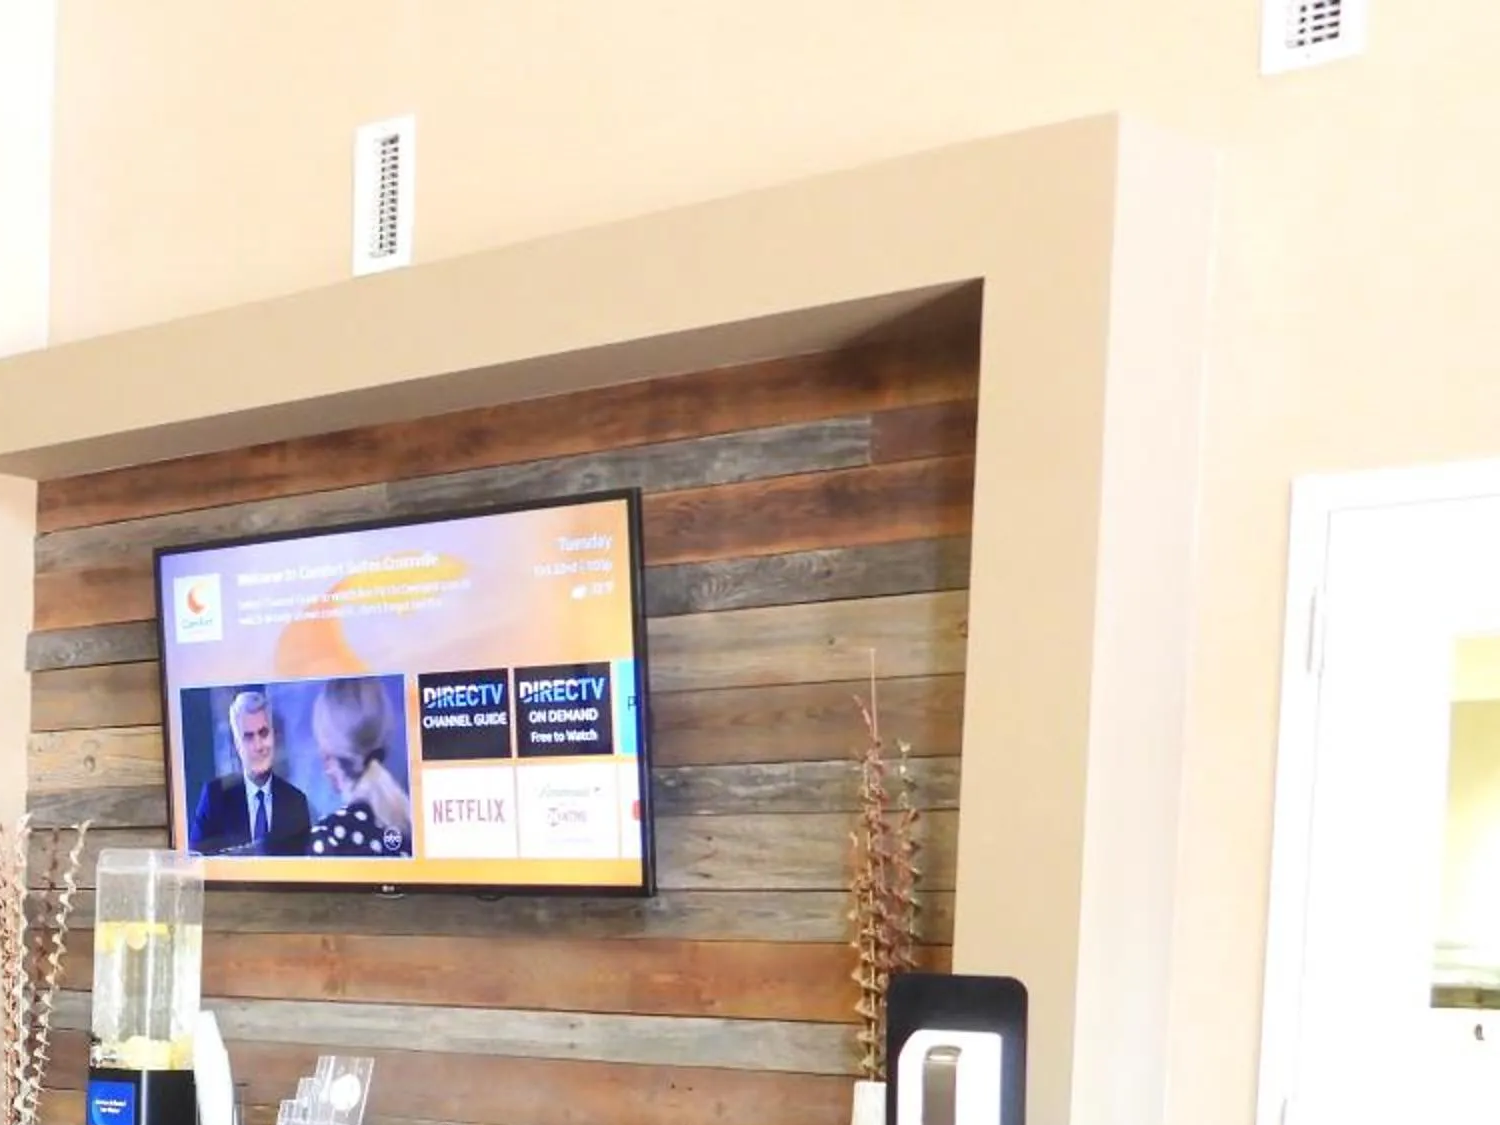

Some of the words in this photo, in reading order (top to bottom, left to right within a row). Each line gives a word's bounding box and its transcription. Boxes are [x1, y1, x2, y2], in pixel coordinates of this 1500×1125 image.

[423, 683, 503, 708] DIRECTV
[519, 677, 604, 703] DIRECTV
[423, 713, 473, 729] CHANNEL
[474, 711, 508, 726] GUIDE
[529, 710, 547, 724] ON
[548, 708, 599, 722] DEMAND
[530, 731, 553, 743] Free
[553, 731, 565, 742] to
[566, 729, 598, 741] Watch
[432, 799, 506, 824] NETFLIX
